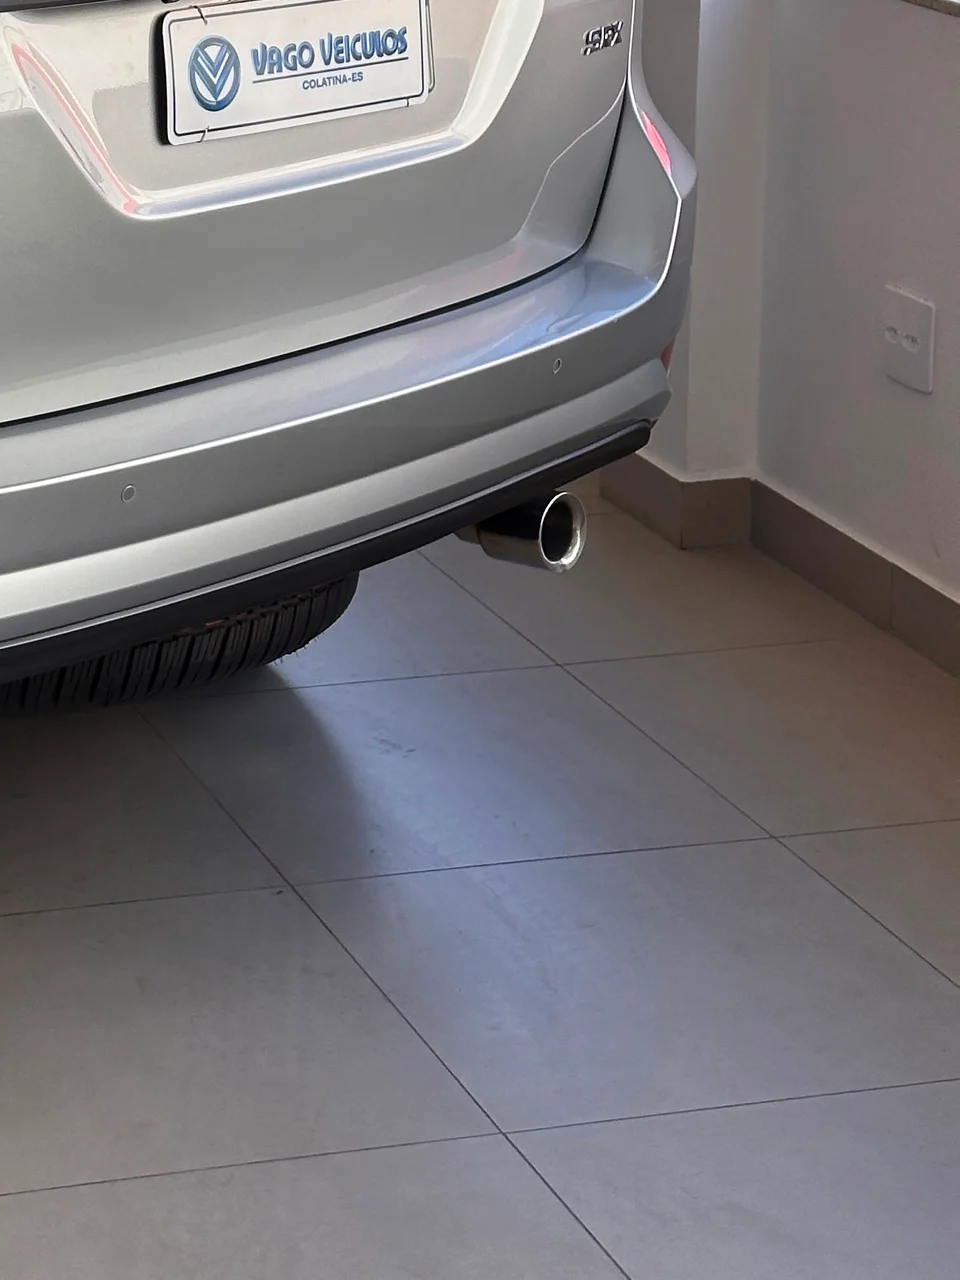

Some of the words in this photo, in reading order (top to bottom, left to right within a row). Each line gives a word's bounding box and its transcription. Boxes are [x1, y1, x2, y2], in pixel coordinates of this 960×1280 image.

[251, 40, 315, 76] VAGO
[320, 25, 409, 66] VEICULOS
[302, 71, 364, 91] COLATINA-ES
